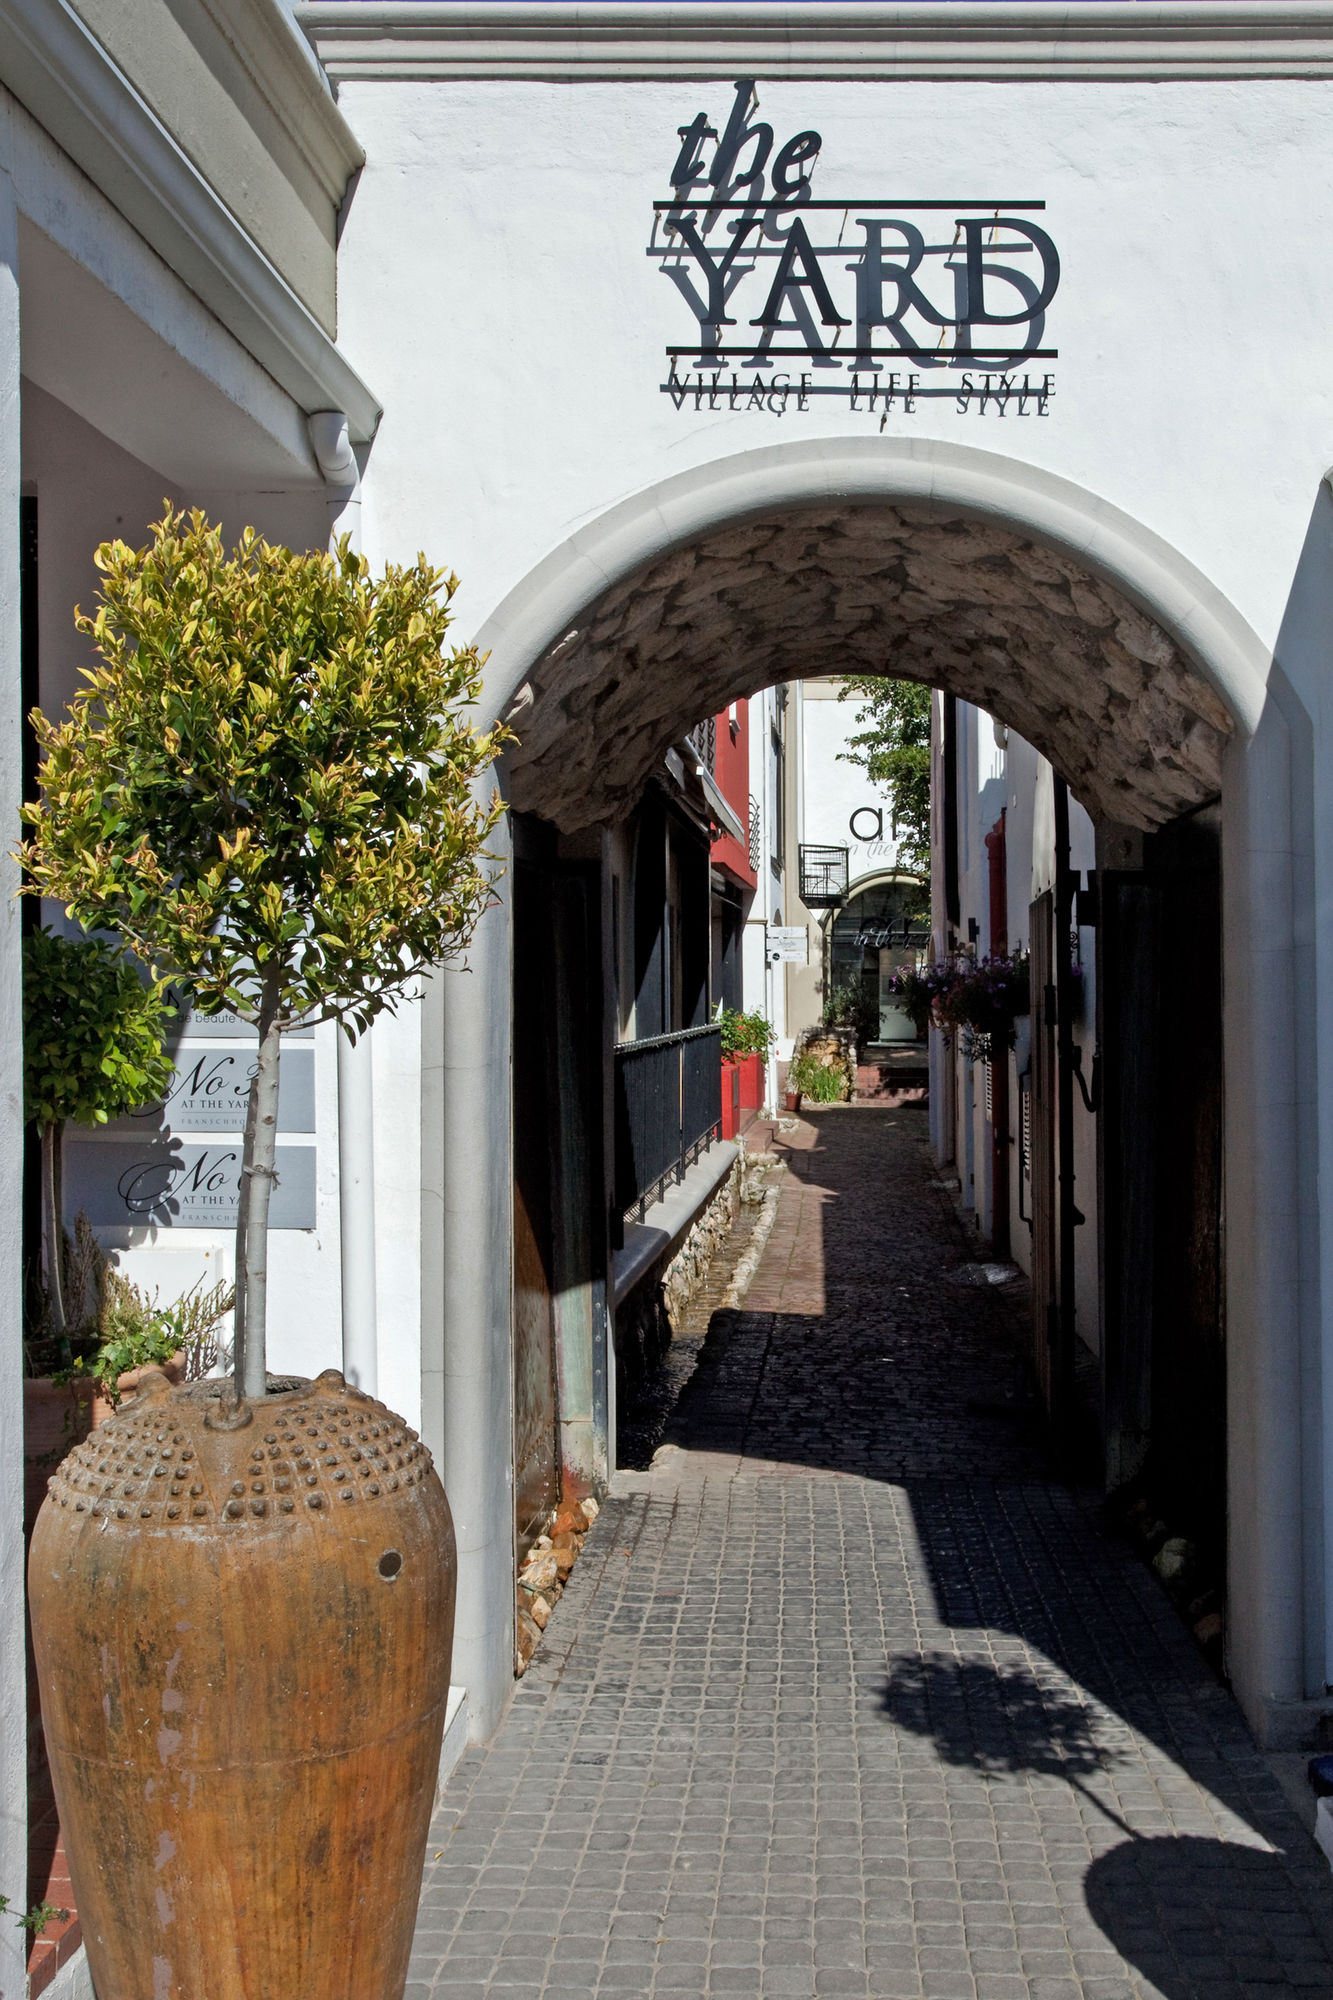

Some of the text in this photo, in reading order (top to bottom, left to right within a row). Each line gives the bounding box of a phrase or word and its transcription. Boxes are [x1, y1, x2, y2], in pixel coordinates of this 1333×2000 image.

[670, 79, 822, 195] the
[667, 216, 1061, 326] YARD
[673, 372, 1056, 397] VILLAGE LIFE STYLE
[181, 1100, 249, 1109] AT THE YAR
[182, 1196, 196, 1205] AT
[201, 1196, 224, 1205] THE
